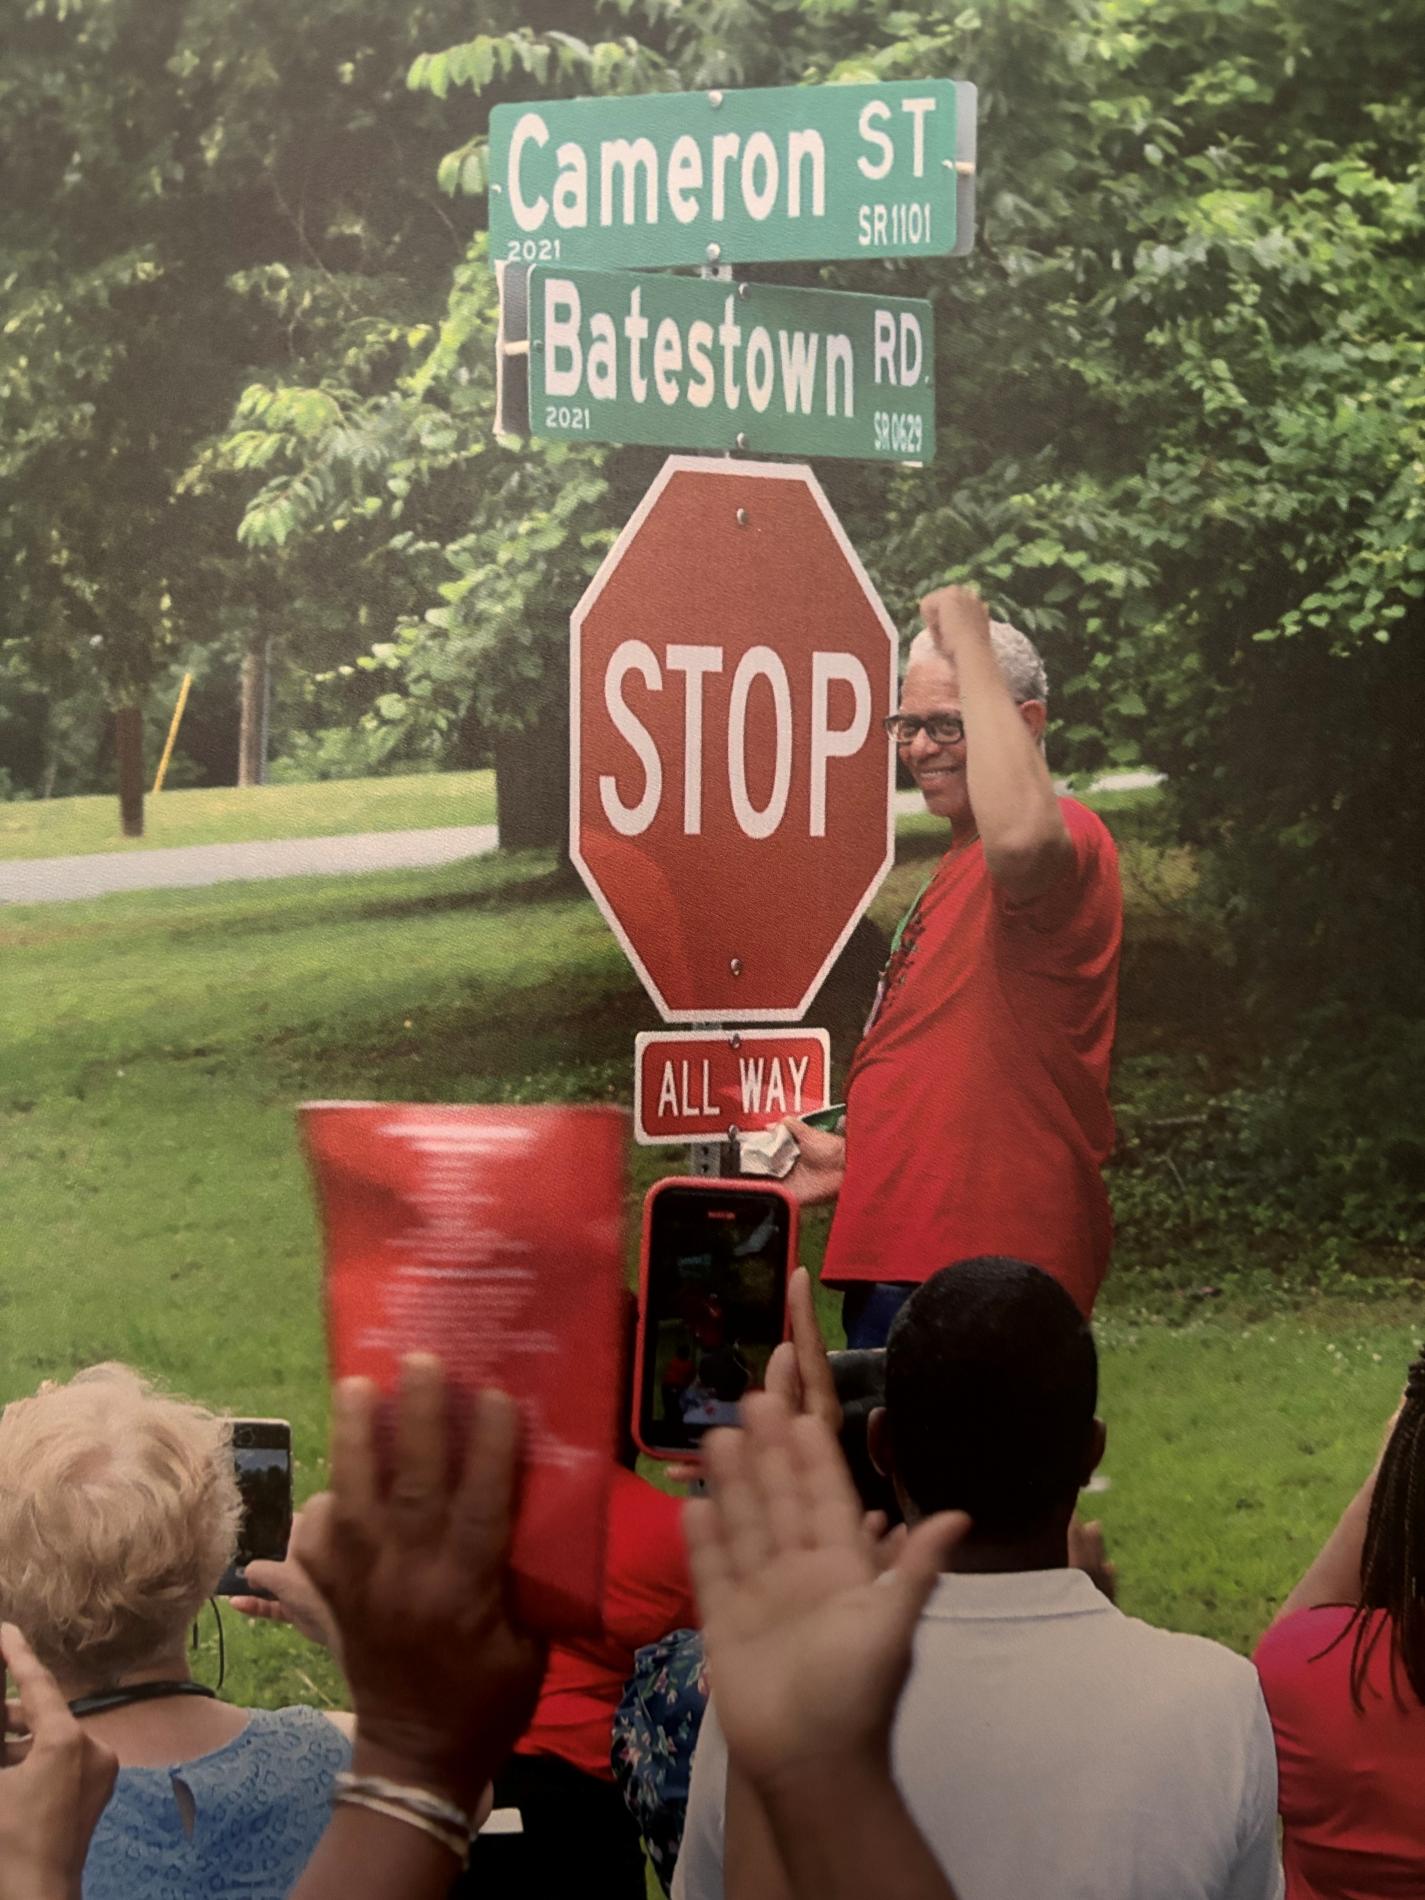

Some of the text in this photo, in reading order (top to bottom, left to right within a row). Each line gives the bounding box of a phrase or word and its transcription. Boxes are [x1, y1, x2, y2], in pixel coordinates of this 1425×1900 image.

[508, 98, 936, 232] Cameron ST
[507, 239, 560, 262] 2021
[544, 278, 854, 418] Batestown
[545, 406, 590, 429] 2021
[599, 639, 872, 839] STOP
[657, 1055, 809, 1117] ALL WAY
